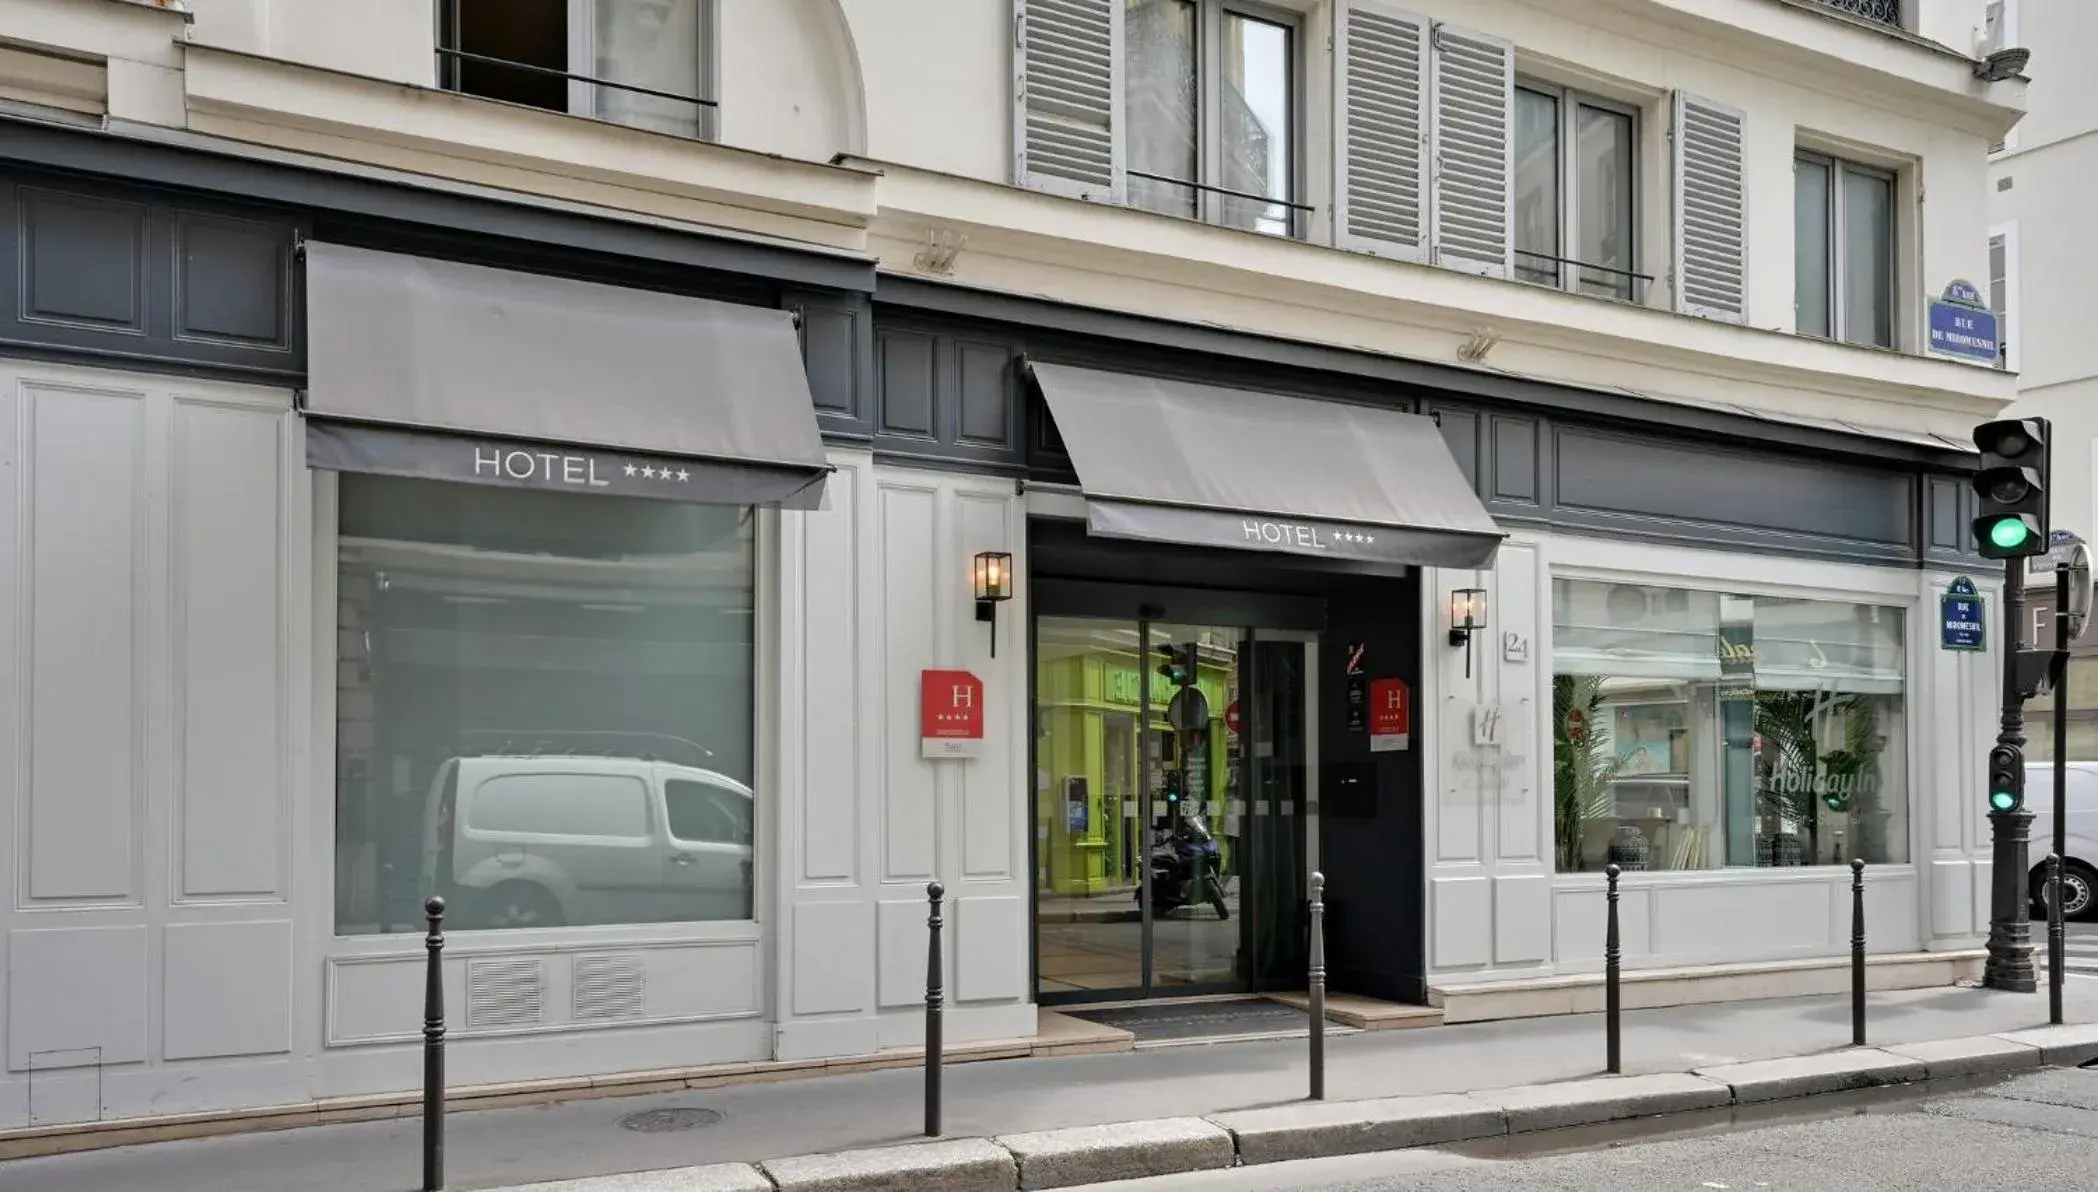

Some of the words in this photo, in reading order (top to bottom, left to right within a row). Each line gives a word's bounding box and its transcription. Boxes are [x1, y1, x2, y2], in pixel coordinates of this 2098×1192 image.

[474, 447, 610, 487] HOTEL
[1242, 519, 1326, 549] HOTEL
[952, 685, 974, 708] H
[1387, 688, 1401, 709] H
